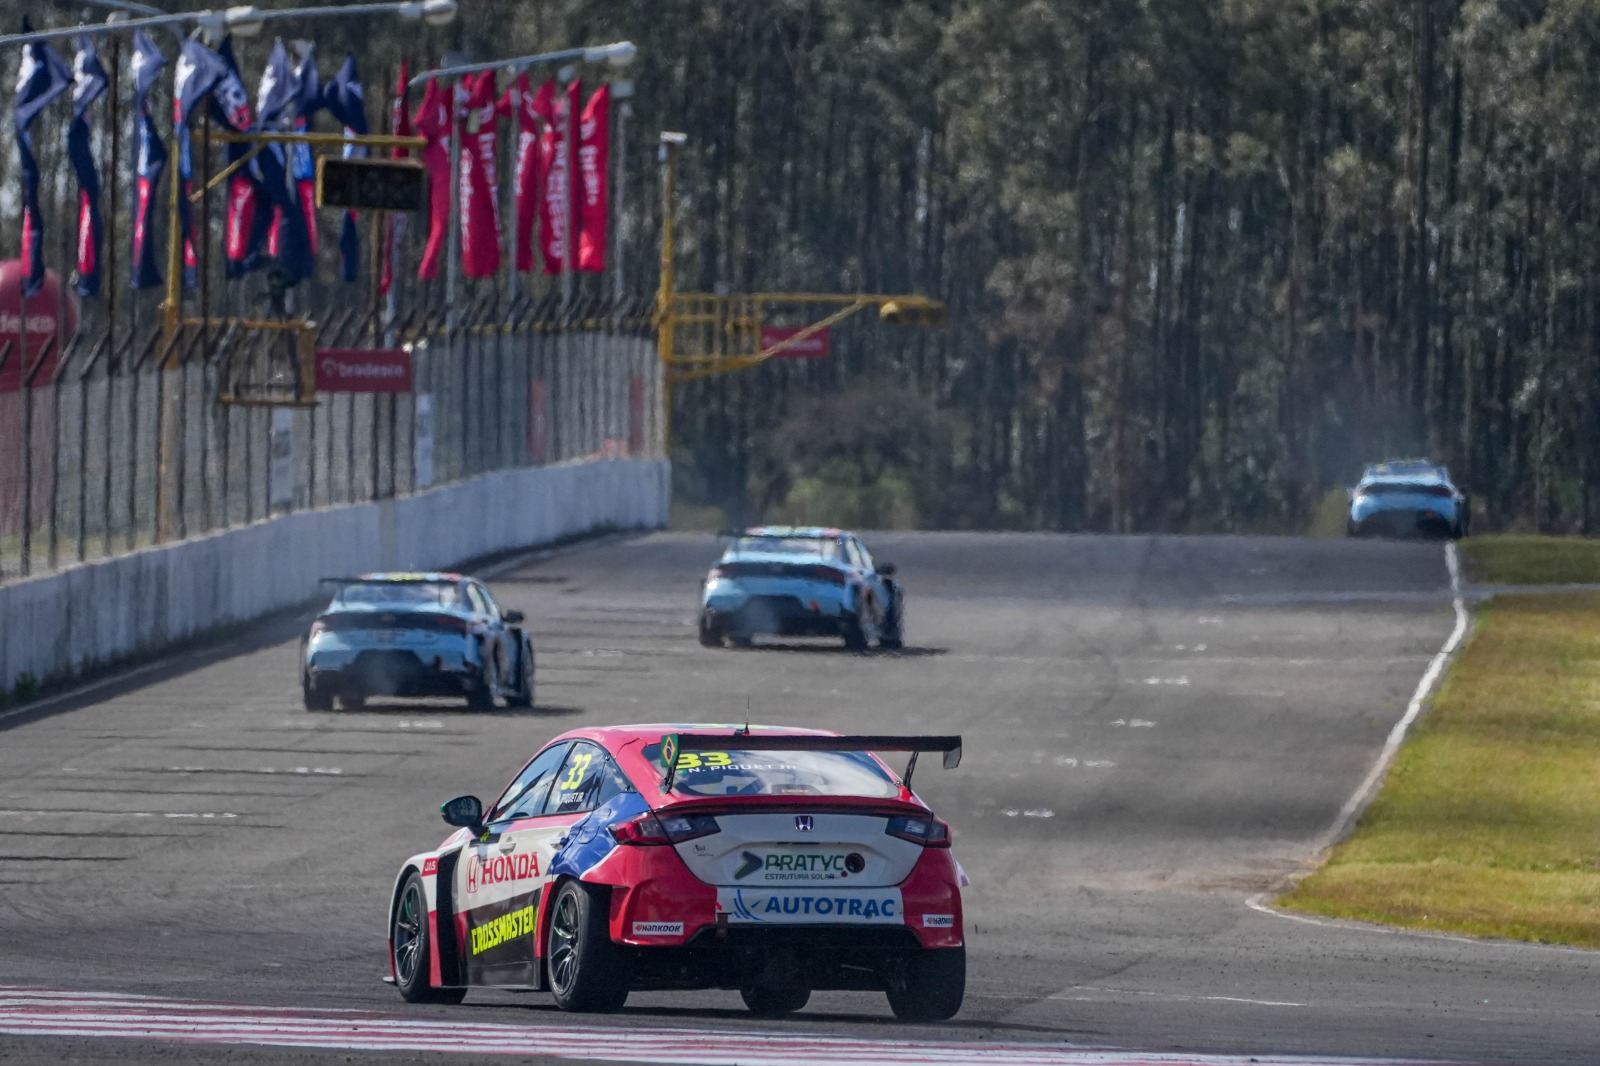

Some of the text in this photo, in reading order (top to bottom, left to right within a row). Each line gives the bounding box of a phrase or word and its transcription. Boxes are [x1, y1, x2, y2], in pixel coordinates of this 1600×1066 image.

[675, 751, 732, 770] 33
[711, 763, 772, 772] PIQUET
[560, 753, 592, 790] 33
[424, 861, 437, 872] JAS
[481, 852, 540, 886] HONDA
[765, 854, 845, 871] PRATYC
[764, 873, 835, 881] ESTRUTURA SOLAR
[764, 896, 895, 917] AUTOTRAC
[471, 905, 535, 956] CROSSMASTER
